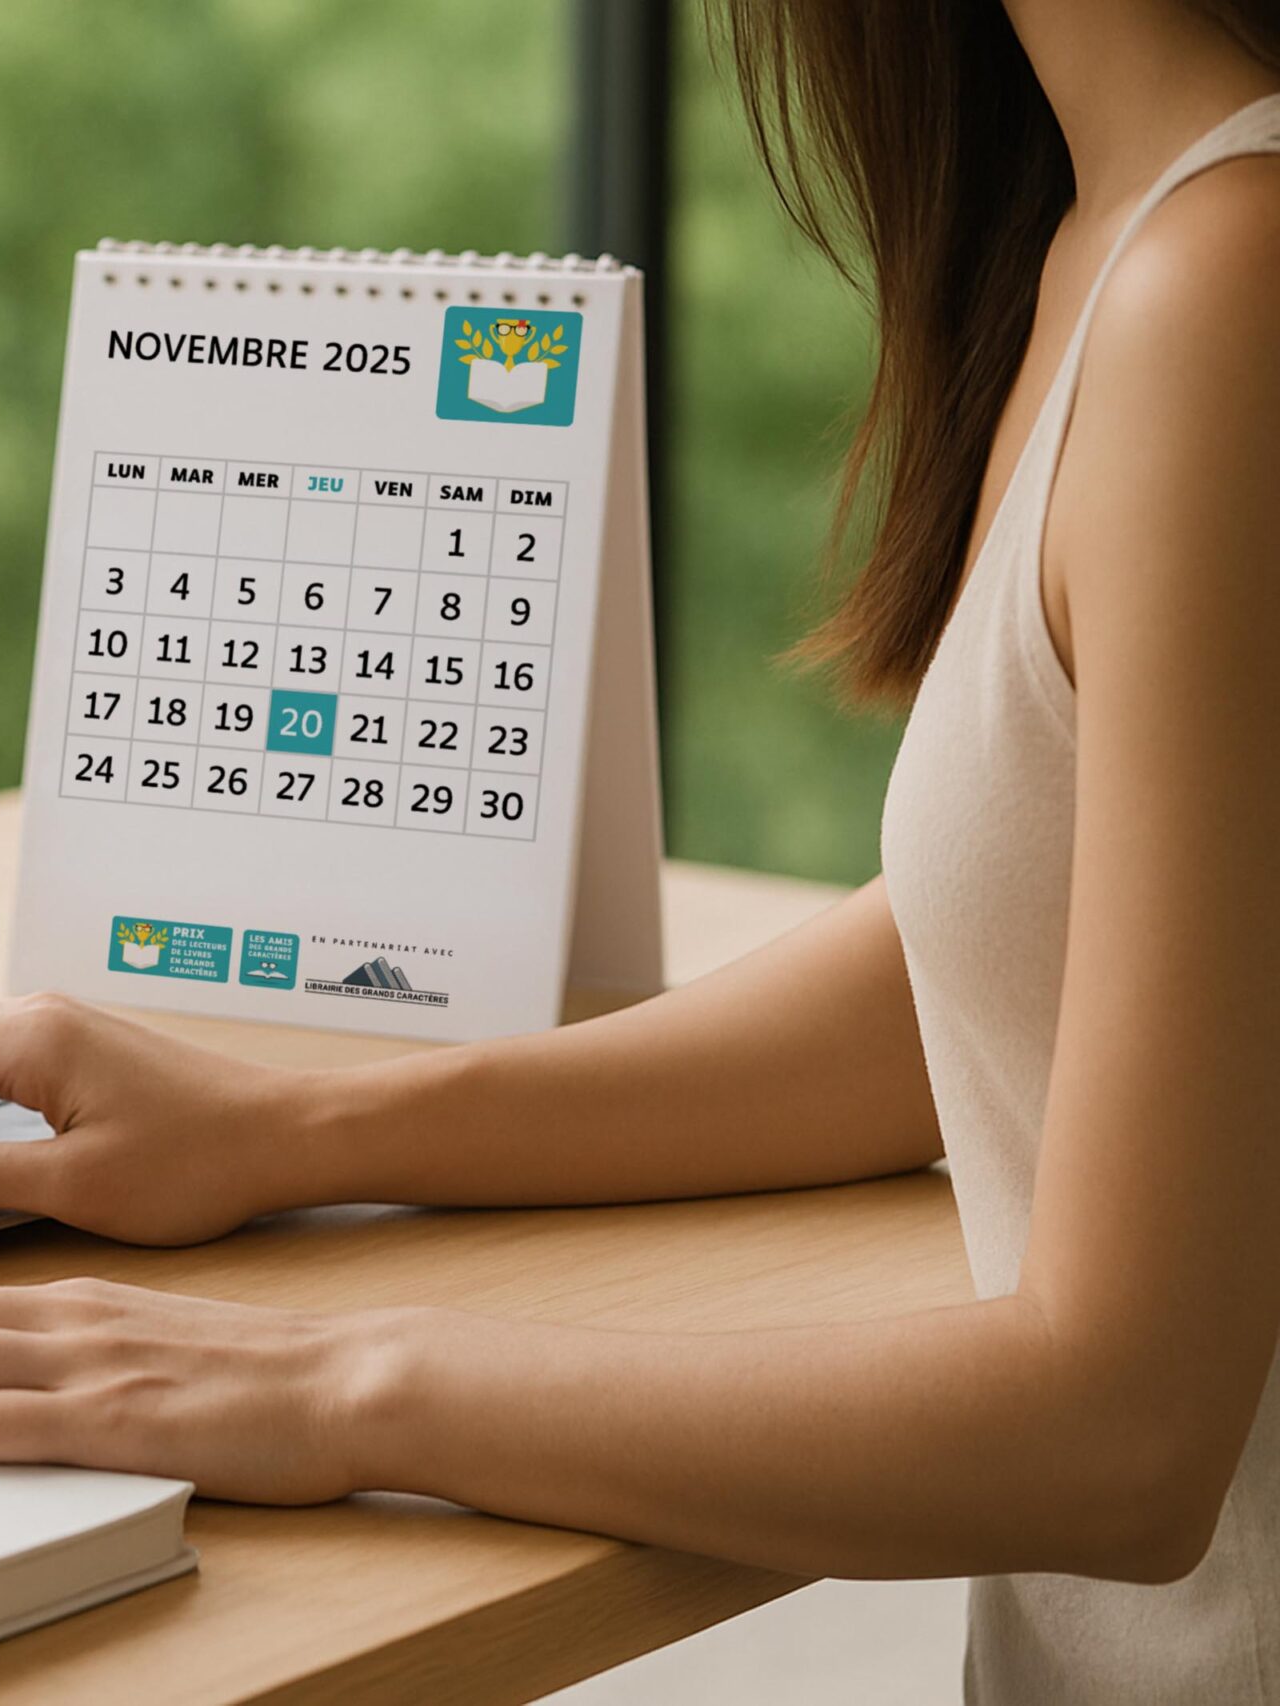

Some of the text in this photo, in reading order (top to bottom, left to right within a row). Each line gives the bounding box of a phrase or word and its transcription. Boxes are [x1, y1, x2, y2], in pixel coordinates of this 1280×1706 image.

[109, 331, 410, 375] NOVEMBRE 2025
[108, 463, 552, 506] LUN MAR MER JEU VEN SAM DIM
[449, 529, 535, 562] 1 2
[106, 568, 530, 626] 3 4 5 6 7 8 9
[89, 629, 533, 691] 10 11 12 13 14 15 16
[84, 692, 528, 755] 17 18 19 20 21 22 23
[75, 754, 523, 820] 24 25 26 27 28 29 30
[173, 927, 205, 939] PRIX
[268, 937, 293, 946] AMIS
[184, 950, 212, 958] LIVRES
[189, 941, 227, 951] LECTEURS
[248, 951, 291, 960] CARACTÈRES
[264, 945, 292, 953] GRANDS
[333, 938, 418, 952] PARTENARIAT
[424, 948, 454, 957] AVEC
[170, 966, 217, 977] CARACTÈRES
[183, 959, 215, 967] GRANDS
[305, 982, 448, 1004] LIBRAIRIE DES GRANDS CARACTÈRES
